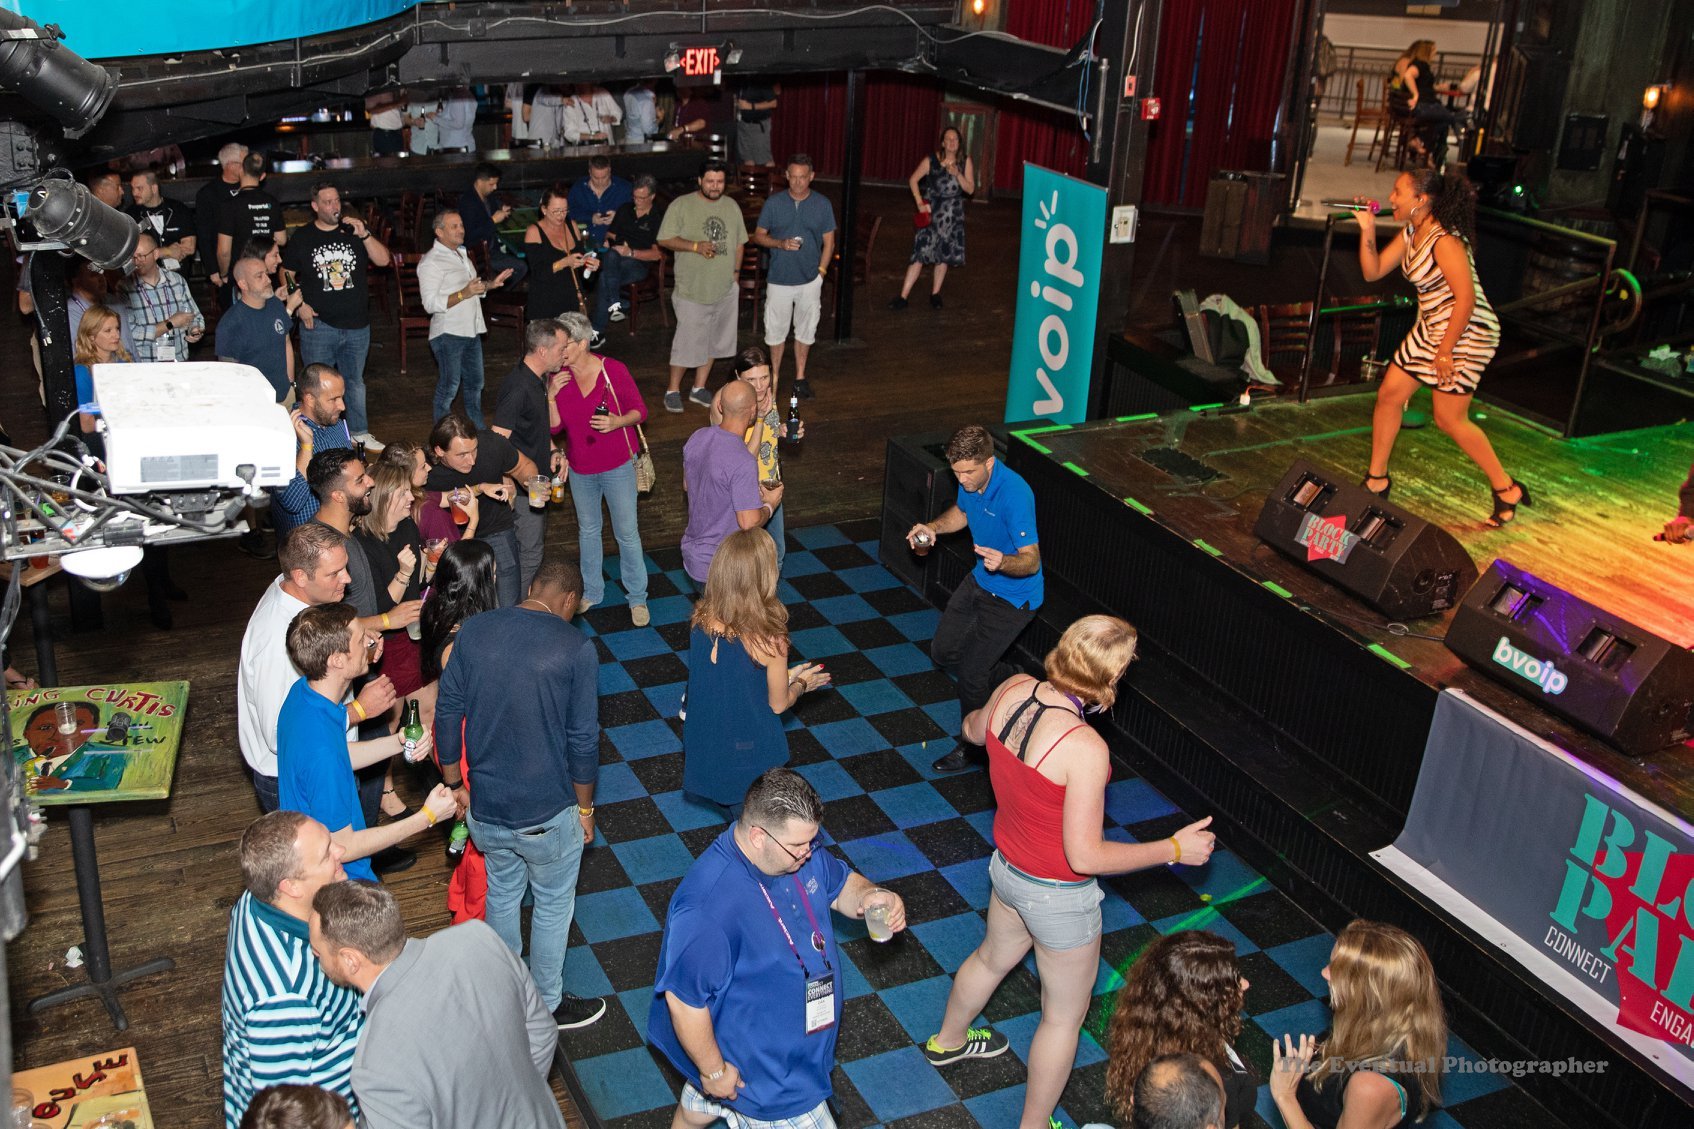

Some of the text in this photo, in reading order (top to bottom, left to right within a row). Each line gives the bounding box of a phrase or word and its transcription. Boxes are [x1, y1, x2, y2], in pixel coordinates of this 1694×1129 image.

[686, 48, 717, 75] EXIT
[1302, 526, 1348, 559] PARTY
[1307, 514, 1355, 546] BLOCK
[1494, 638, 1565, 693] bvoip
[1544, 925, 1612, 984] CONNECT
[1650, 1000, 1694, 1048] ENGA
